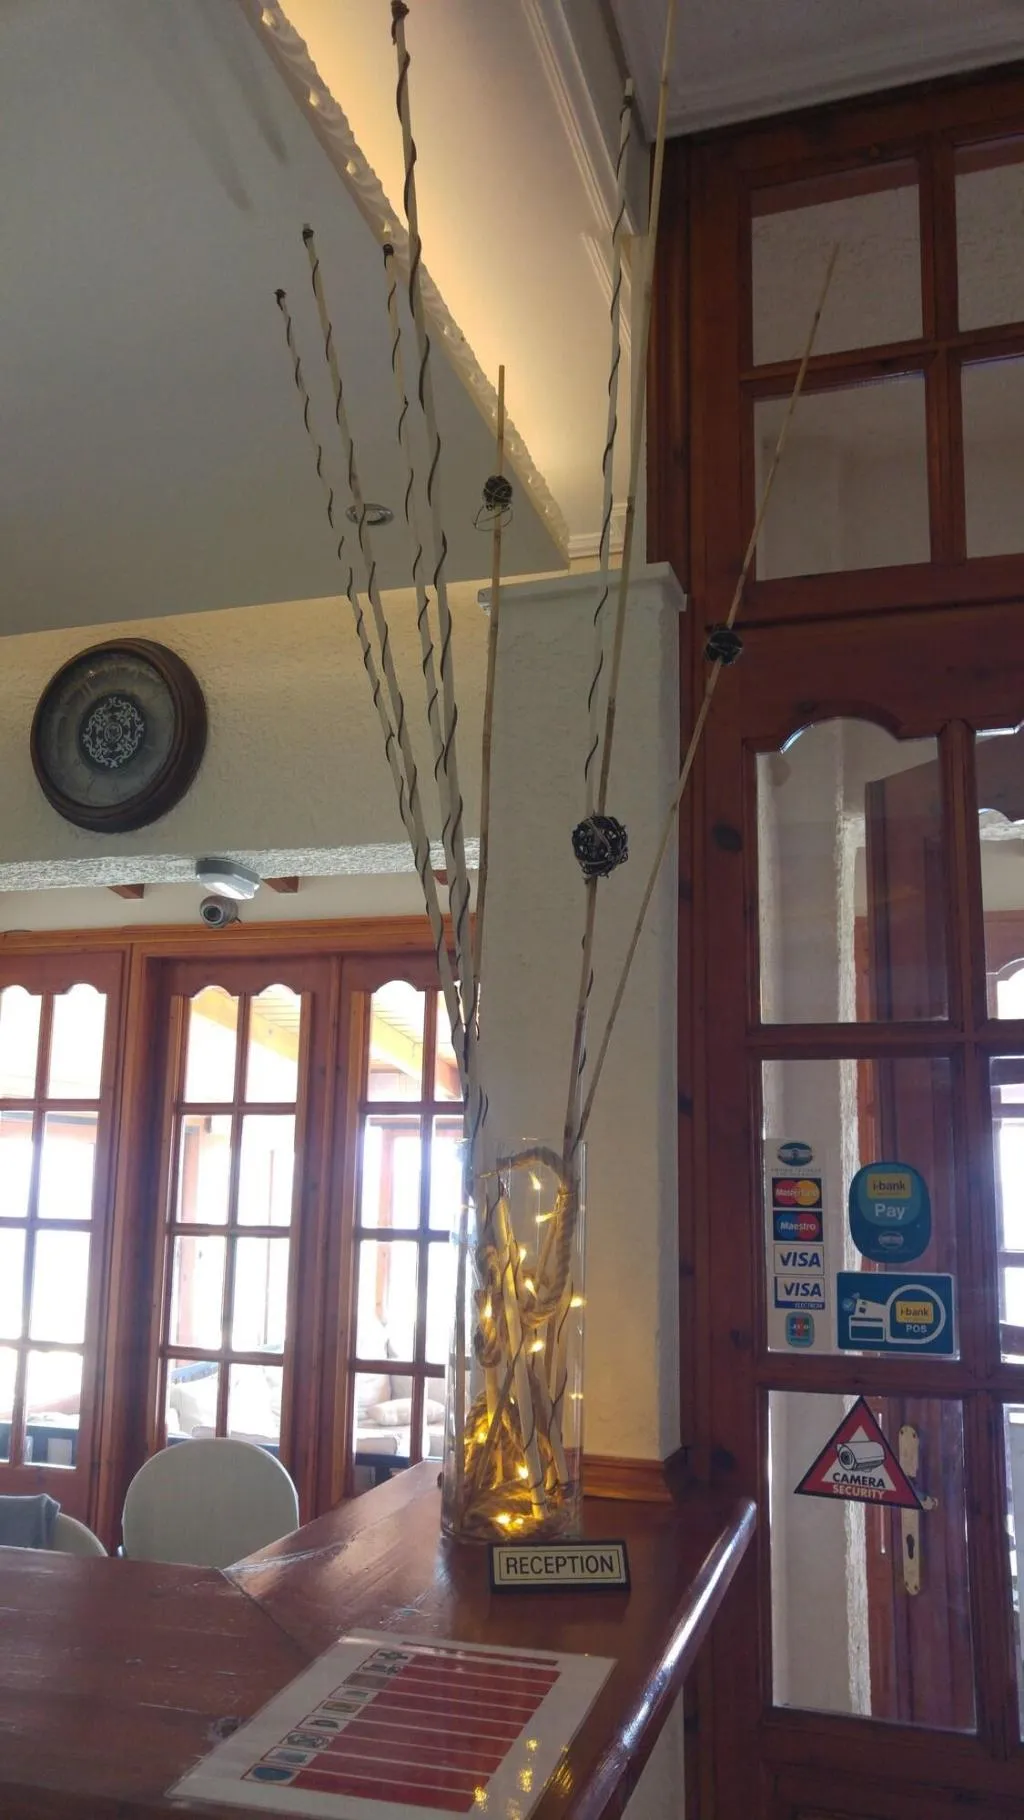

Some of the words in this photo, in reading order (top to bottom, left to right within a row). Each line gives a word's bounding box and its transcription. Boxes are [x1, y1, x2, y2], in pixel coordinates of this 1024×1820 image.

[872, 1179, 906, 1191] i-bank
[874, 1203, 906, 1220] Pay
[780, 1222, 816, 1232] Maestro
[780, 1252, 821, 1267] VISA
[784, 1283, 821, 1297] VISA
[900, 1306, 929, 1317] i-bank
[905, 1323, 927, 1333] POS
[833, 1472, 886, 1488] CAMERA
[832, 1484, 885, 1499] SECURITY
[505, 1555, 614, 1575] RECEPTION
